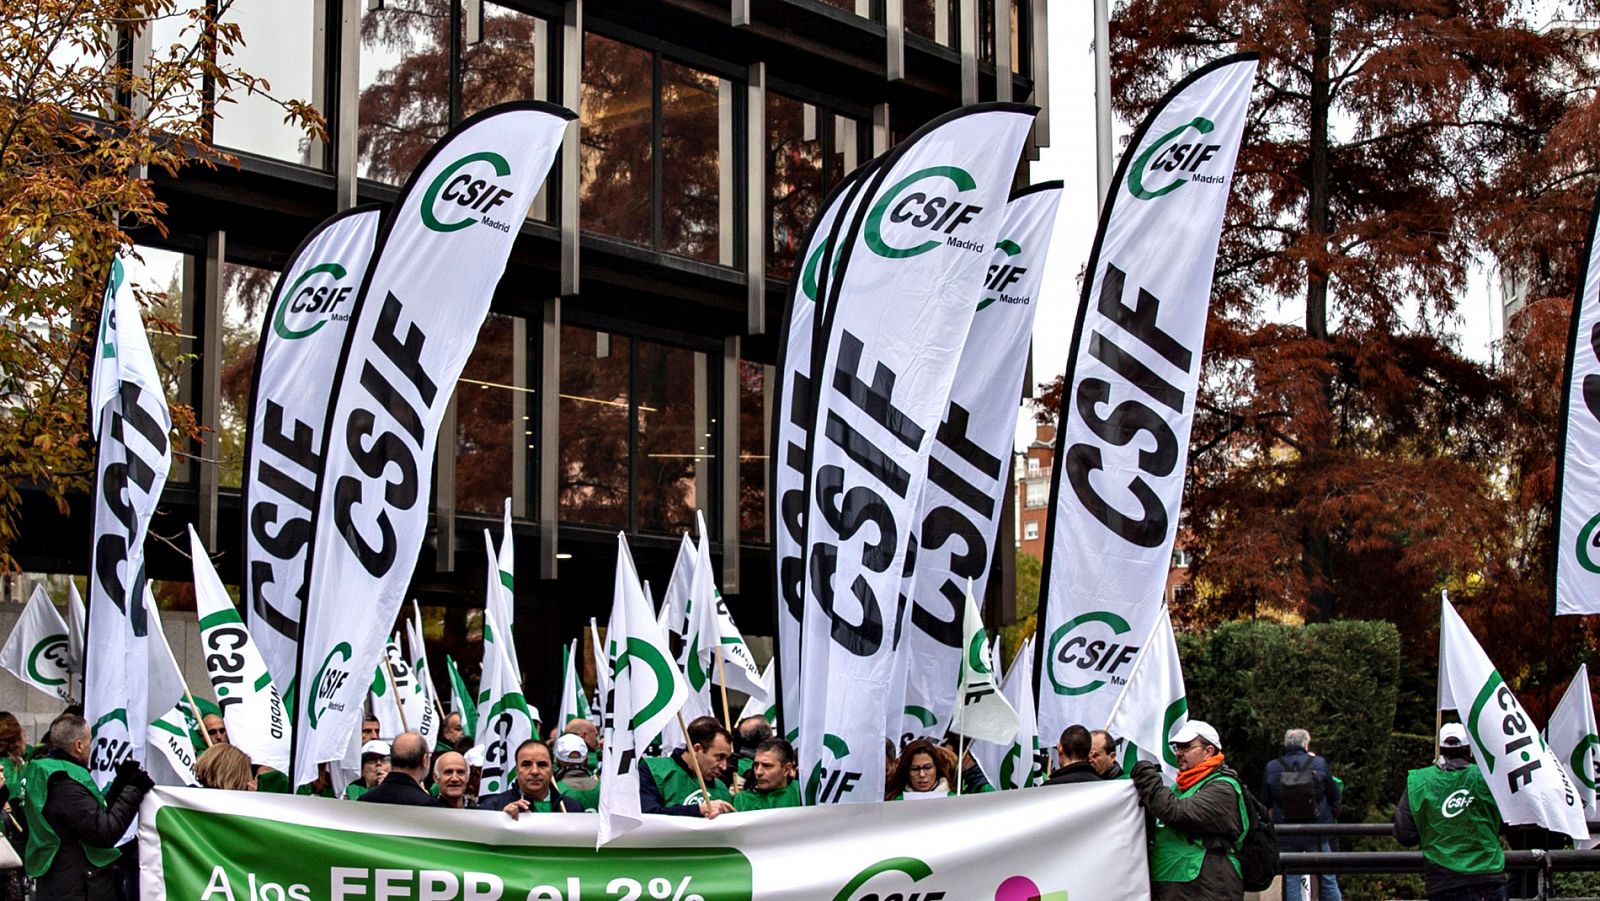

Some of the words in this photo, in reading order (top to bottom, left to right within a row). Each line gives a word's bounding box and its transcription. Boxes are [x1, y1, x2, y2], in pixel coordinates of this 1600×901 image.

[1150, 143, 1221, 173] CSIF
[441, 173, 513, 214] CSIF
[1191, 173, 1225, 185] Madrid
[481, 214, 511, 234] Madrid
[889, 192, 983, 235] CSIF
[947, 236, 984, 254] Madrid
[983, 264, 1028, 293] SIF
[290, 286, 353, 314] CSIF
[999, 293, 1030, 306] Madrid
[331, 313, 351, 323] Mad
[1066, 261, 1193, 549] CSIF
[334, 290, 439, 579] CSIF
[810, 328, 927, 657] CSIF
[1057, 636, 1140, 675] CSIF
[318, 667, 349, 700] CSIF
[168, 735, 196, 776] MADR
[200, 865, 237, 901] A
